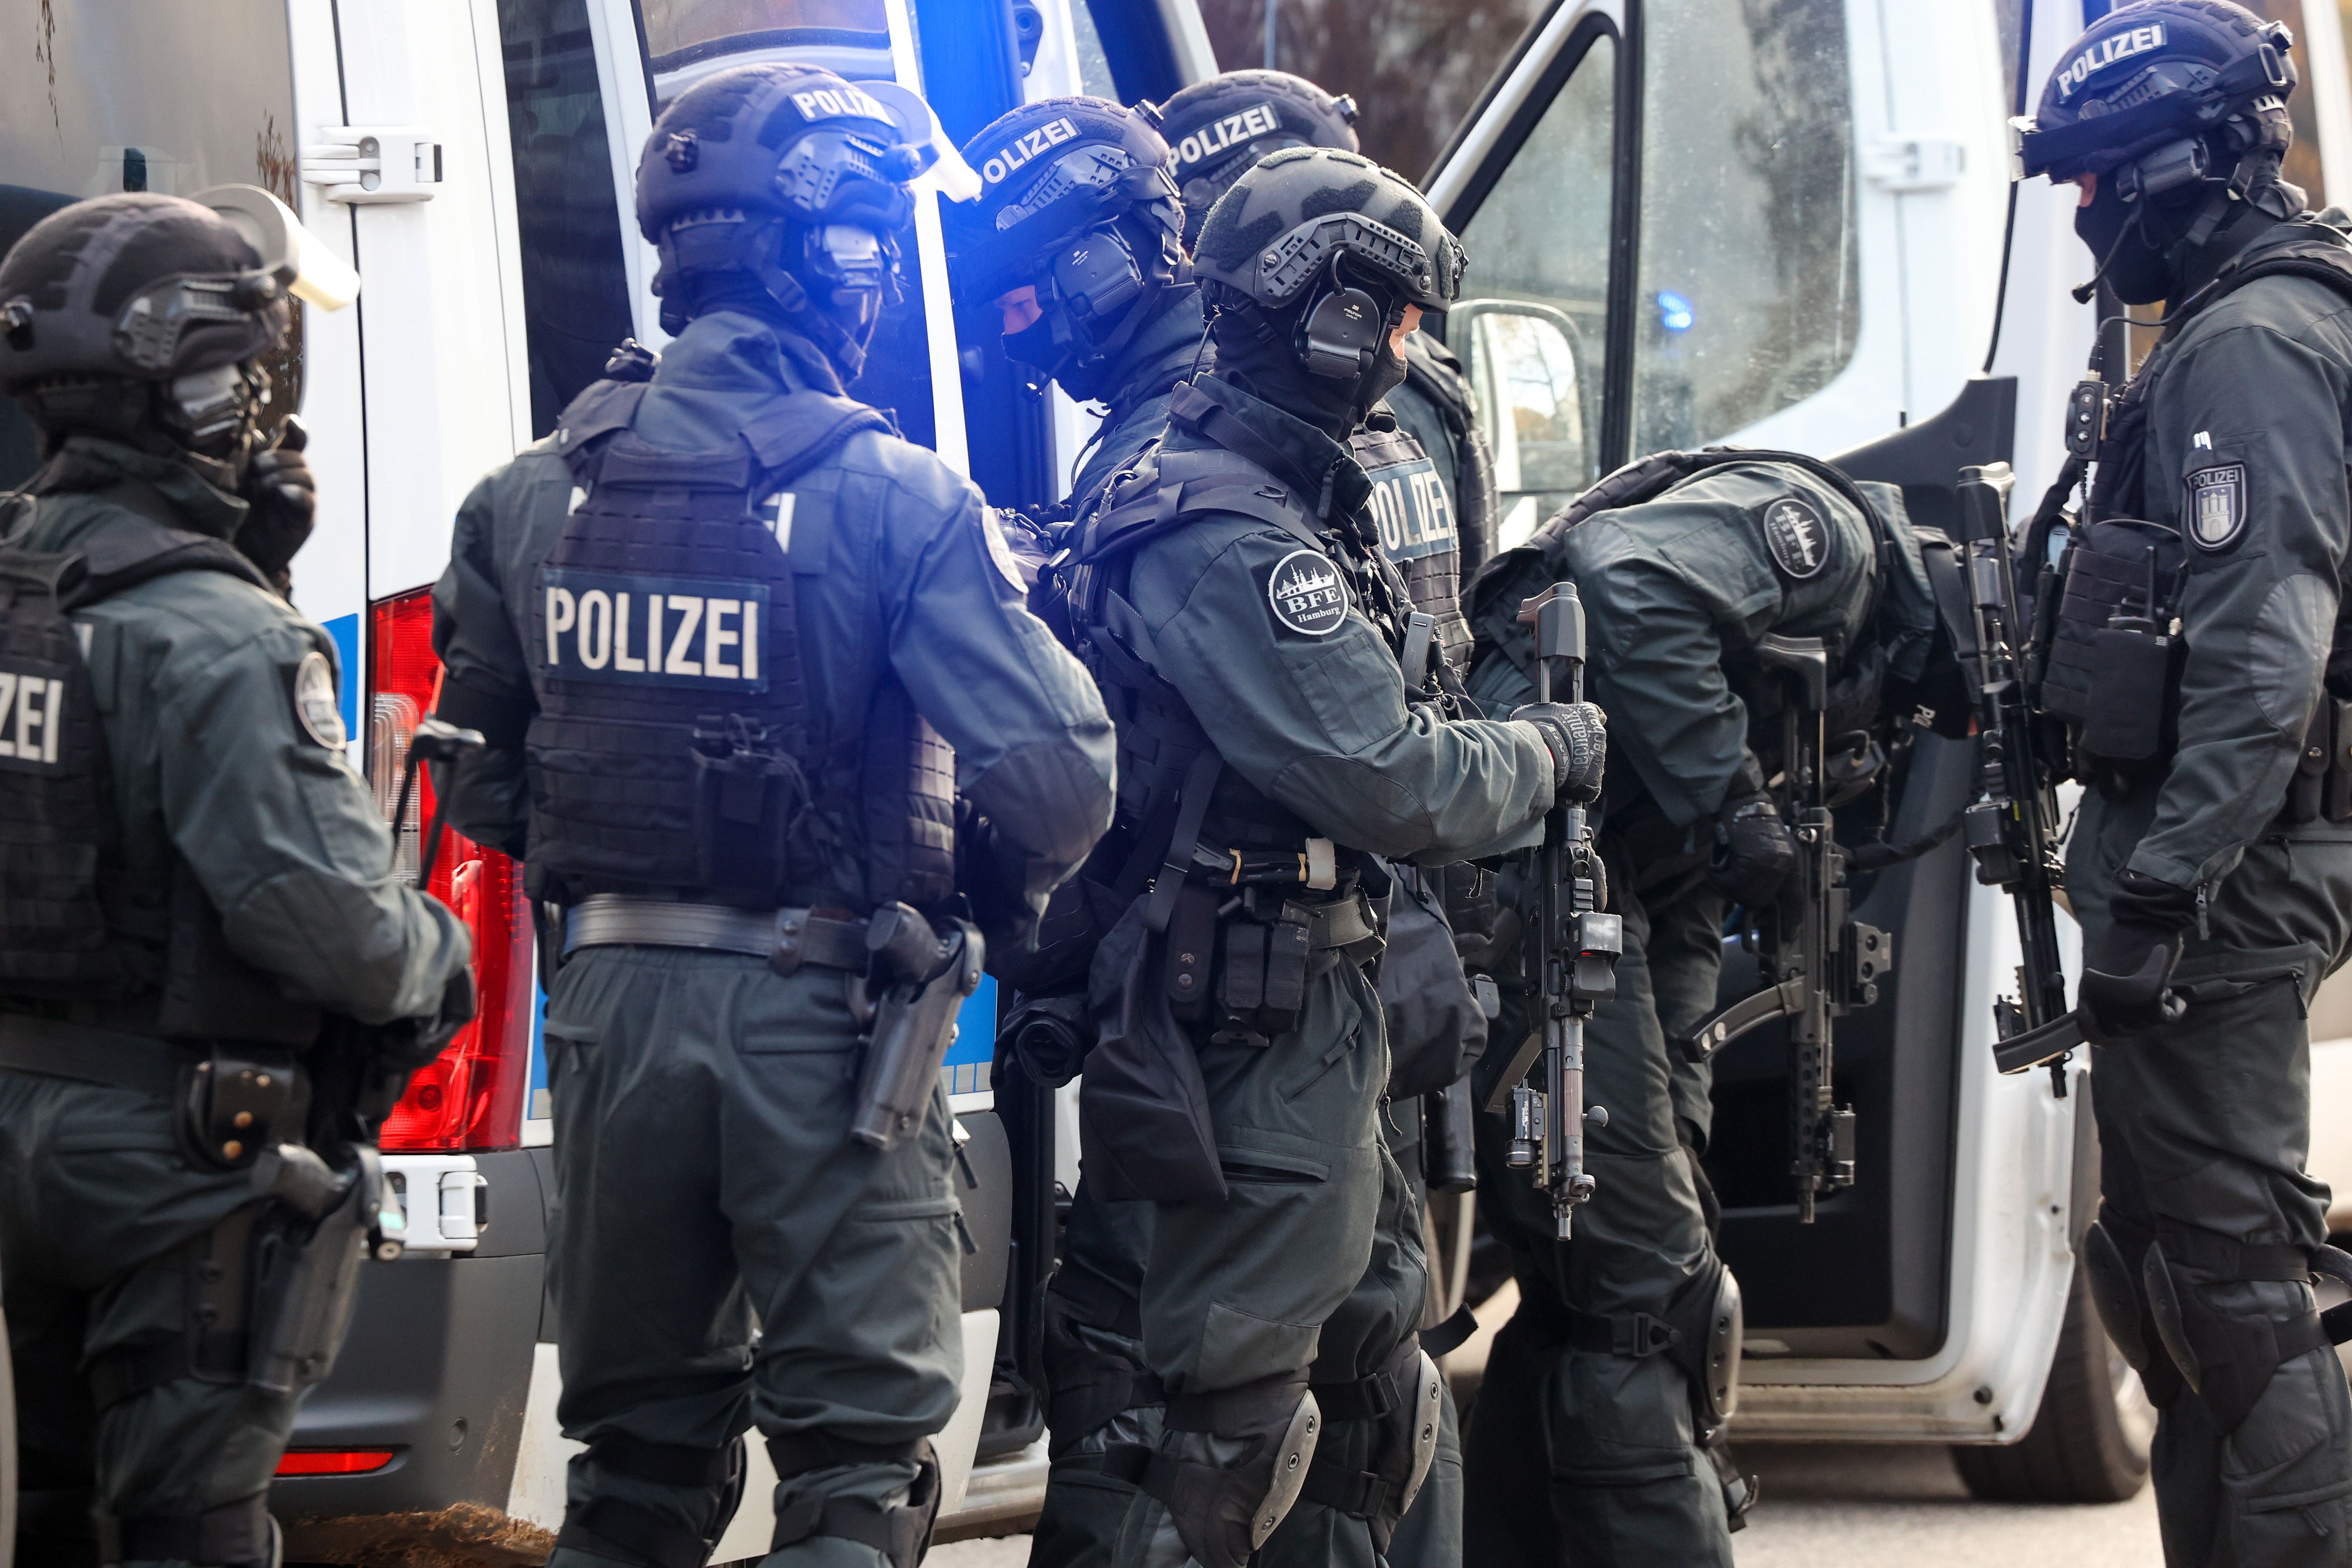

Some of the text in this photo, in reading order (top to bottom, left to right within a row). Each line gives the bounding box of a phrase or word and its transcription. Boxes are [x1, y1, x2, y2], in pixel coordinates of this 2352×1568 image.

[2058, 25, 2162, 97] POLIZEI
[1167, 104, 1277, 177] POLIZEI
[973, 117, 1078, 202] OLIZEI
[1072, 251, 1089, 265] PELTOR
[1344, 308, 1362, 318] PELTOR
[2193, 469, 2239, 487] POLIZEI
[1283, 587, 1341, 614] BFE
[1297, 607, 1341, 623] Hamburg
[546, 587, 759, 680] POLIZEI
